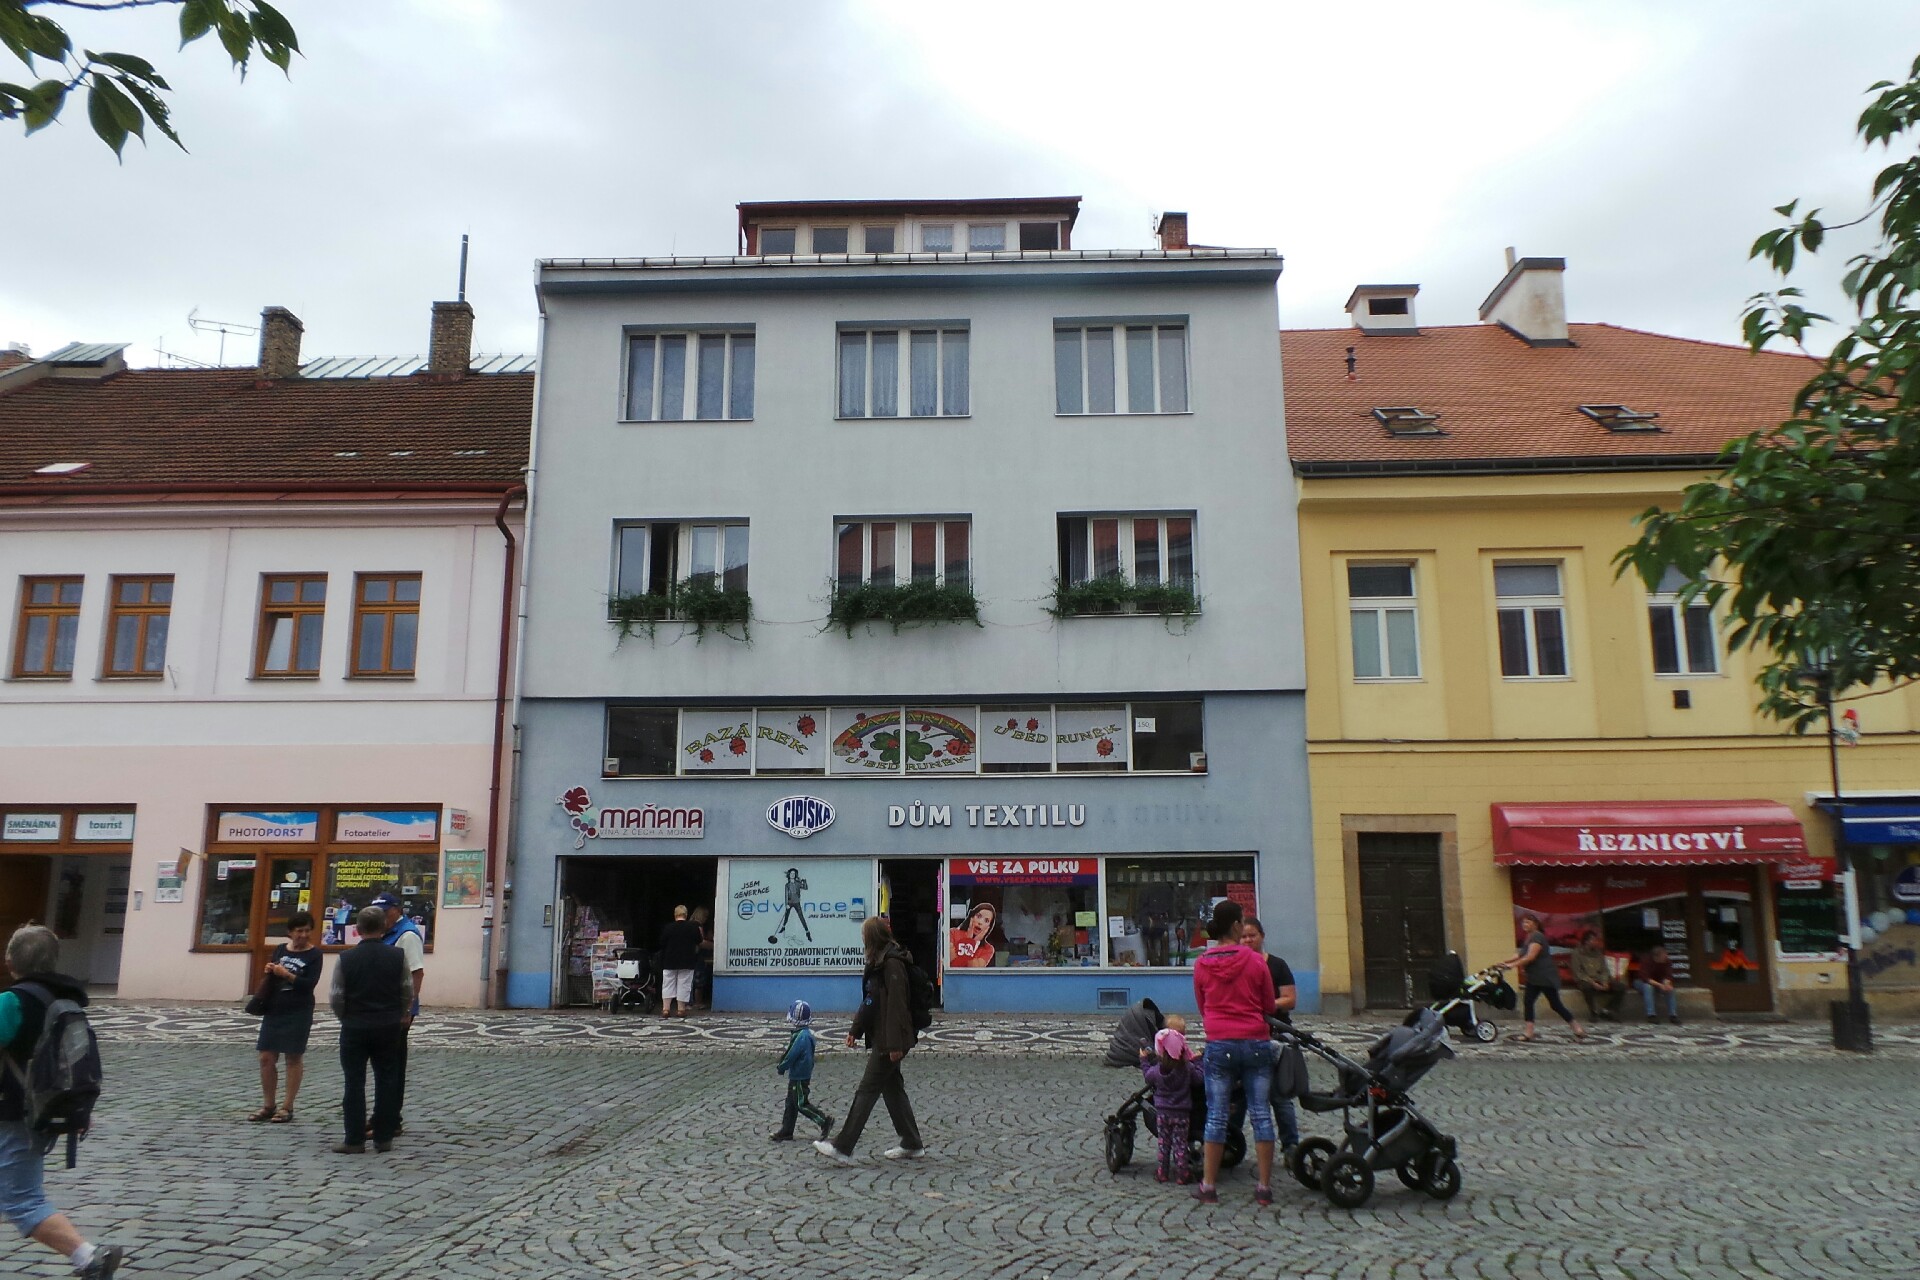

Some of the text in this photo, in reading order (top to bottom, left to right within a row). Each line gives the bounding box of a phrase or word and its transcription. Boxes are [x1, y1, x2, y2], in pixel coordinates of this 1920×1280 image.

[685, 722, 808, 755] BAZÁREK
[600, 803, 703, 829] MAŇANA
[771, 796, 831, 828] U CIPÍSKA
[888, 799, 1086, 827] DŮM TEXTILU
[7, 819, 57, 829] SMĚNÁRNA
[229, 828, 304, 837] PHOTOPORST
[344, 829, 391, 837] Fotoatelier
[600, 828, 619, 836] VÍNA
[631, 827, 655, 836] ČECH
[1578, 826, 1747, 851] ŘEZNICTVÍ
[968, 860, 998, 874] VŠE
[1002, 861, 1024, 874] ZA
[741, 880, 760, 890] JSEM
[734, 886, 770, 899] GENERACE
[729, 947, 782, 957] MINISTERSTVO
[784, 945, 840, 956] ZDRAVOTNICTVÍ
[729, 957, 768, 967] KOUŘENÍ
[770, 956, 821, 966] ZPŮSOBUJE
